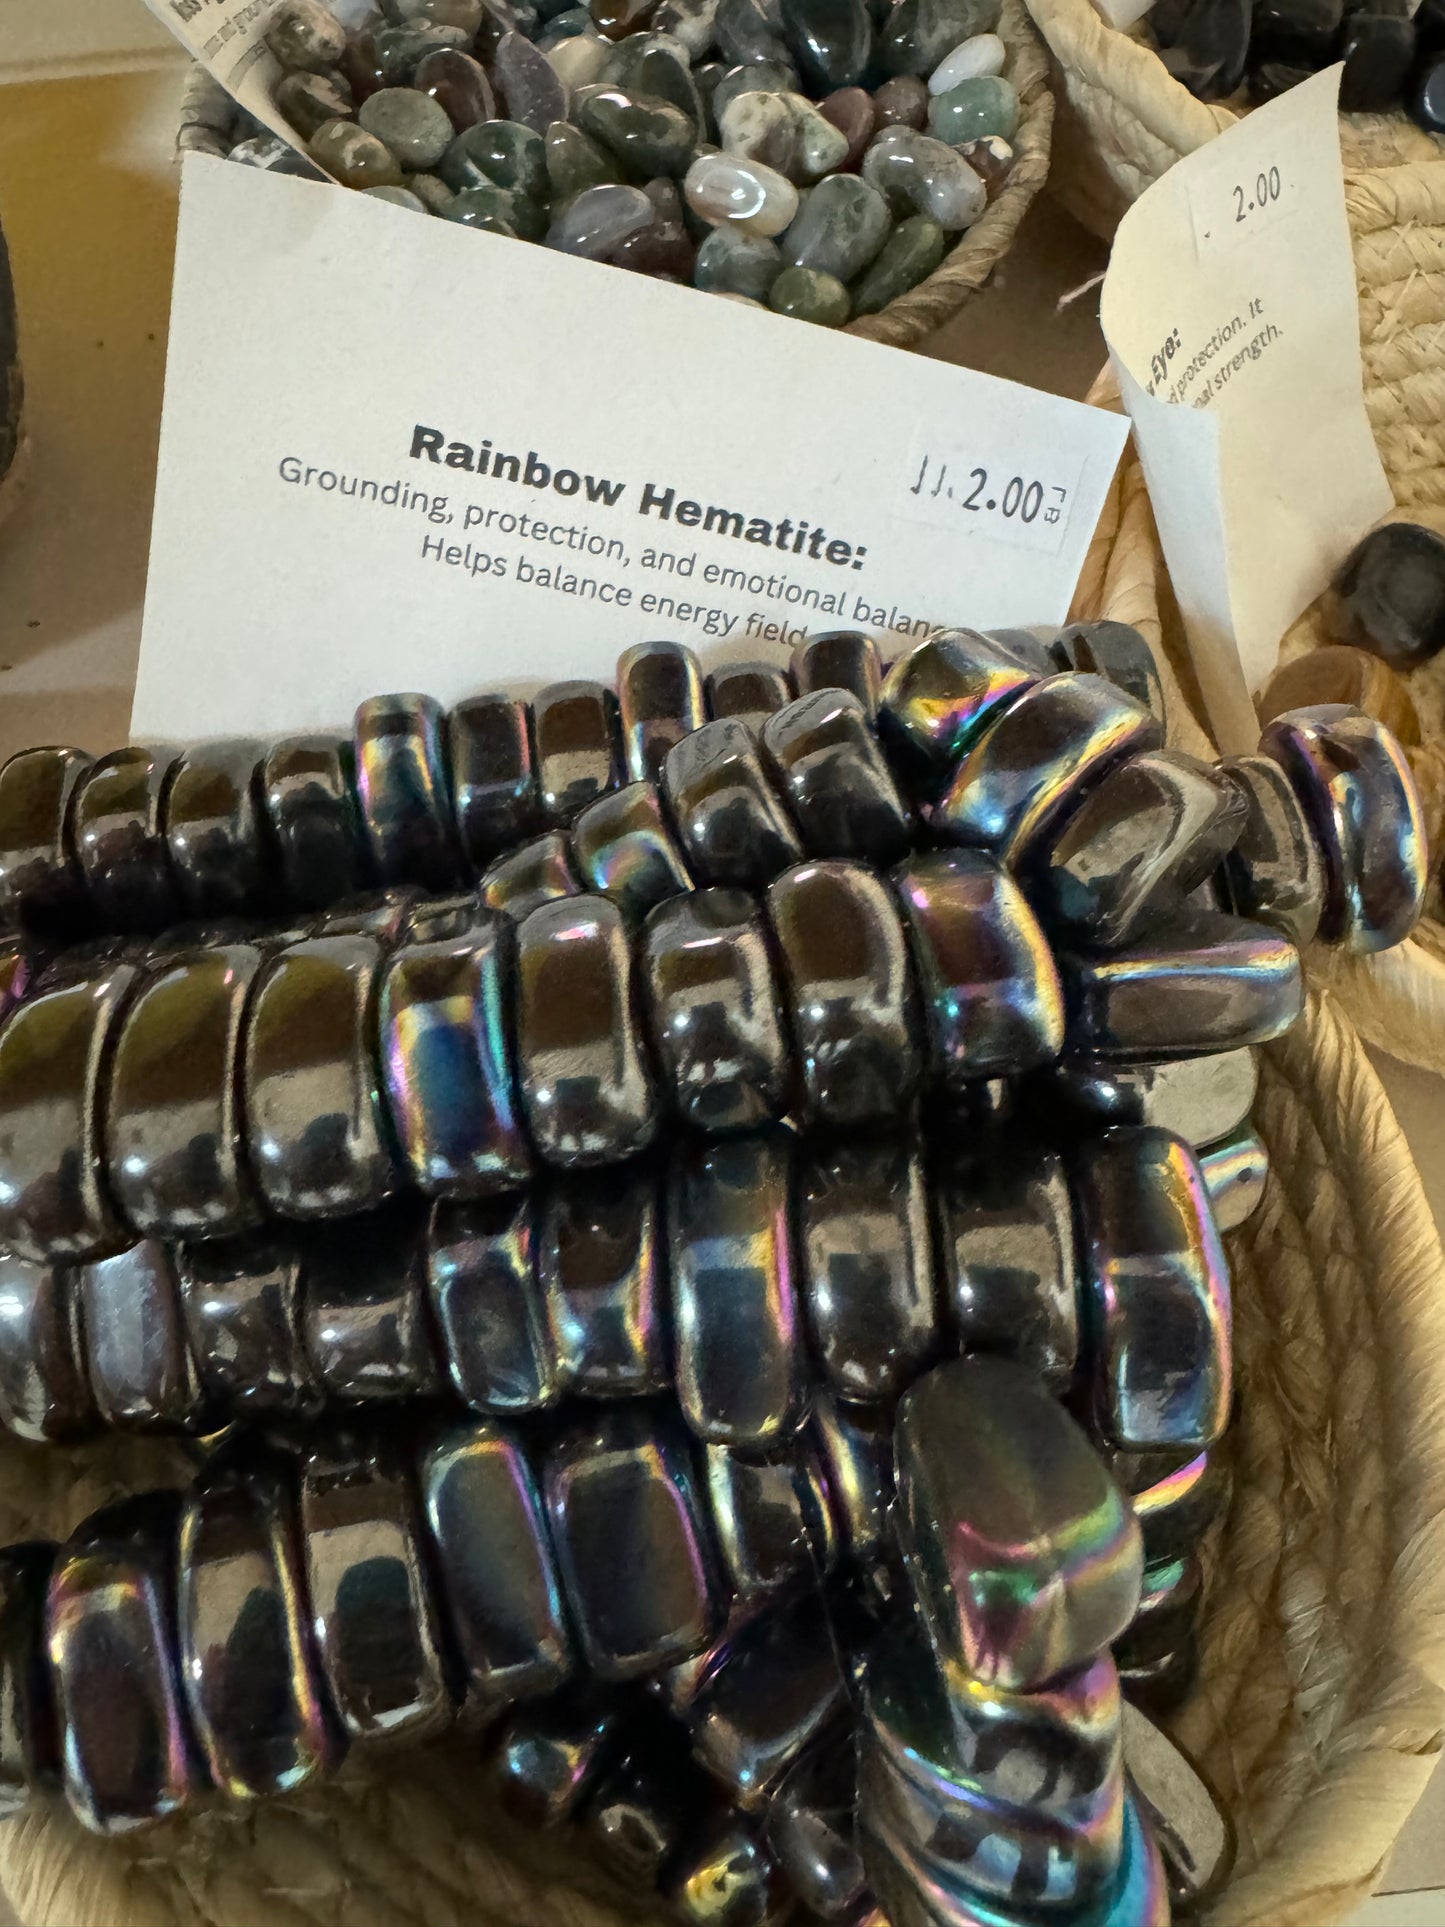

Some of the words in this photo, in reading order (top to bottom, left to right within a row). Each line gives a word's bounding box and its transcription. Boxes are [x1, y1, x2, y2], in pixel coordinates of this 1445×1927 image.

[1232, 165, 1281, 223] 2.00
[1177, 315, 1247, 402] protection.
[1249, 297, 1265, 320] It
[1214, 322, 1284, 390] strength.
[279, 456, 454, 524] Grounding,
[463, 503, 631, 568] protection,
[640, 547, 697, 578] and
[703, 564, 846, 616] emotional
[852, 595, 945, 638] balan
[409, 424, 626, 507] Rainbow
[638, 482, 869, 571] Hematite:
[420, 534, 508, 578] Helps
[516, 554, 633, 607] balance
[640, 588, 739, 637] energy
